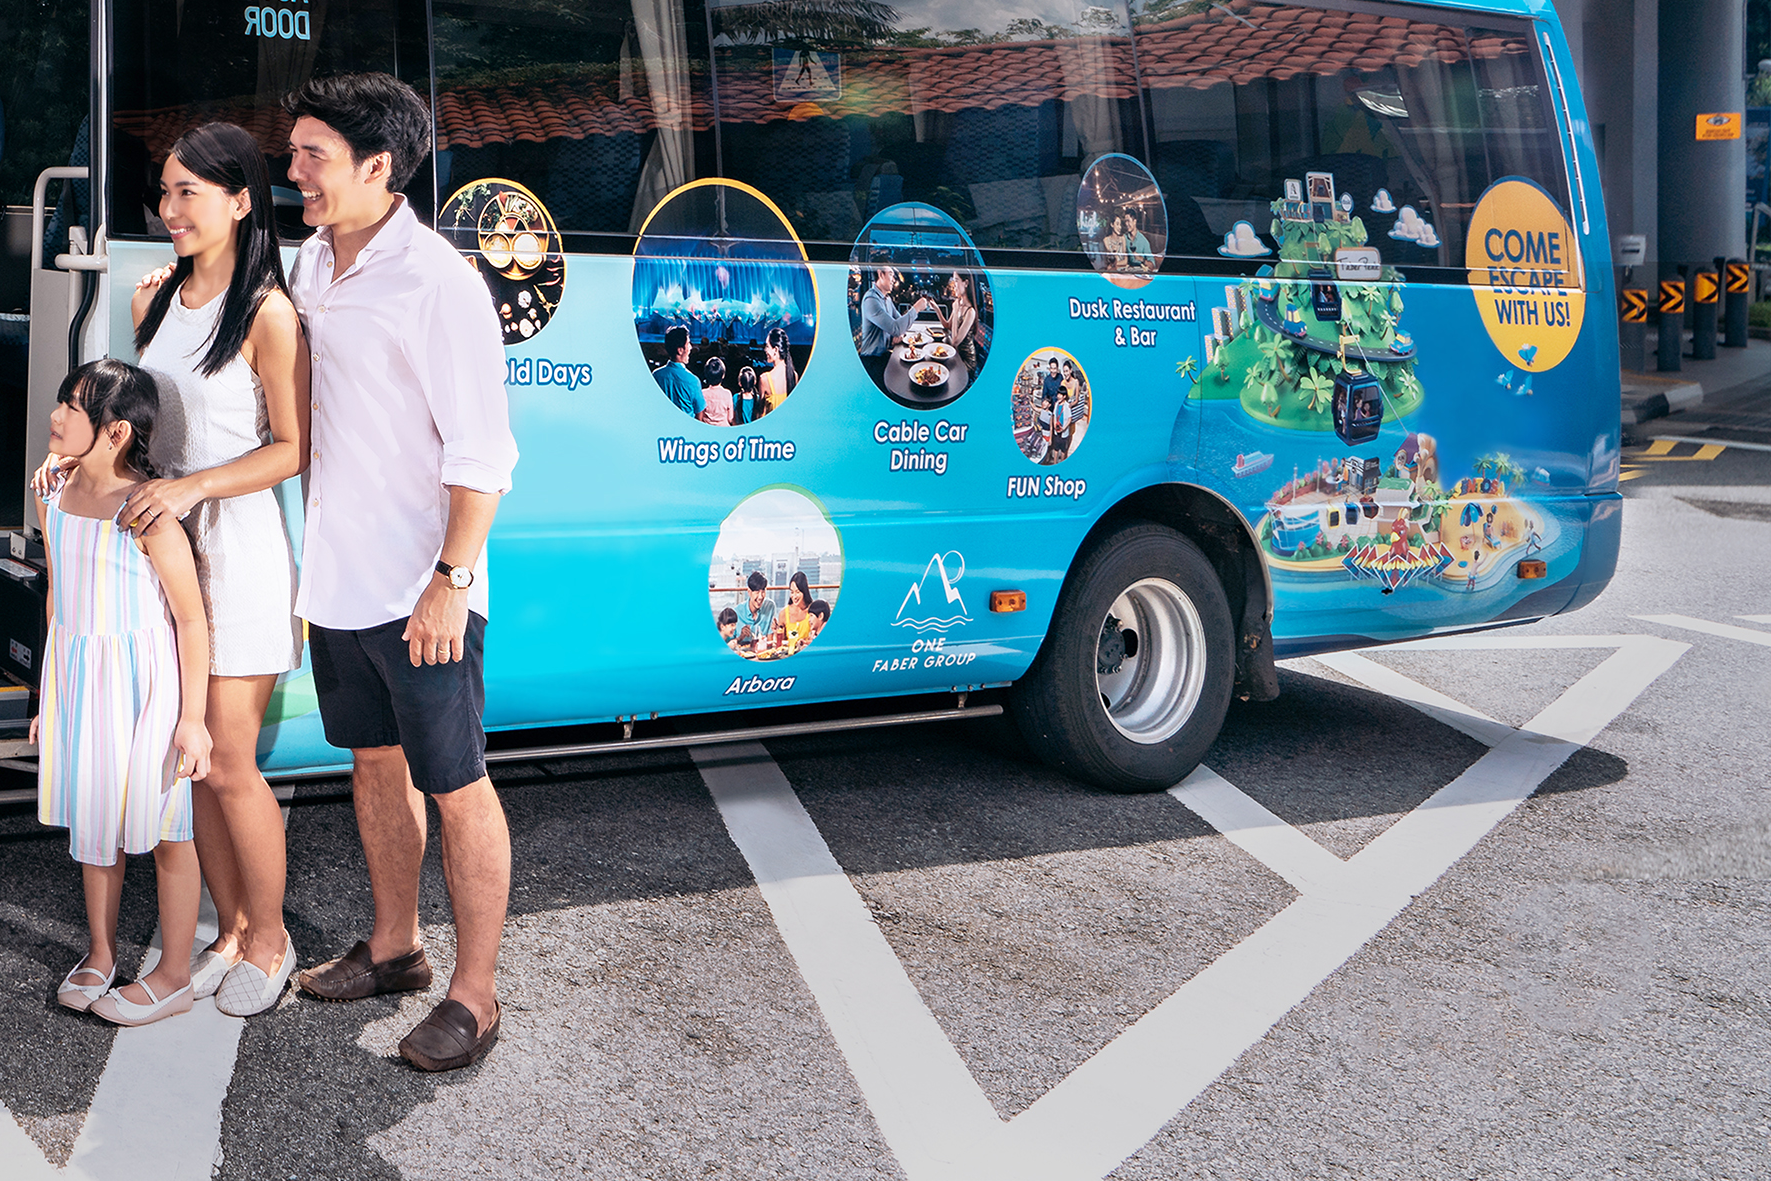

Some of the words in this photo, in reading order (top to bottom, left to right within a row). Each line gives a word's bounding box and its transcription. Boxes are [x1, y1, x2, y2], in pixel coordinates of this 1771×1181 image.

[1484, 228, 1562, 265] COME
[1487, 265, 1568, 297] ESCAPE
[1069, 297, 1110, 319] Dusk
[1112, 298, 1196, 322] Restaurant
[1494, 299, 1539, 326] WITH
[1544, 301, 1571, 327] US!
[1114, 326, 1127, 347] &
[1130, 326, 1157, 347] Bar
[503, 358, 532, 385] ld
[537, 359, 592, 390] Days
[873, 419, 930, 444] Cable
[934, 419, 968, 443] Car
[658, 437, 719, 467] Wings
[724, 436, 745, 461] of
[748, 436, 795, 461] Time
[890, 447, 948, 475] Dining
[1007, 476, 1040, 498] FUN
[1044, 475, 1086, 500] Shop
[911, 637, 946, 653] ONE
[872, 657, 918, 672] FABER
[924, 652, 976, 668] GROUP
[723, 675, 796, 695] Arbora
